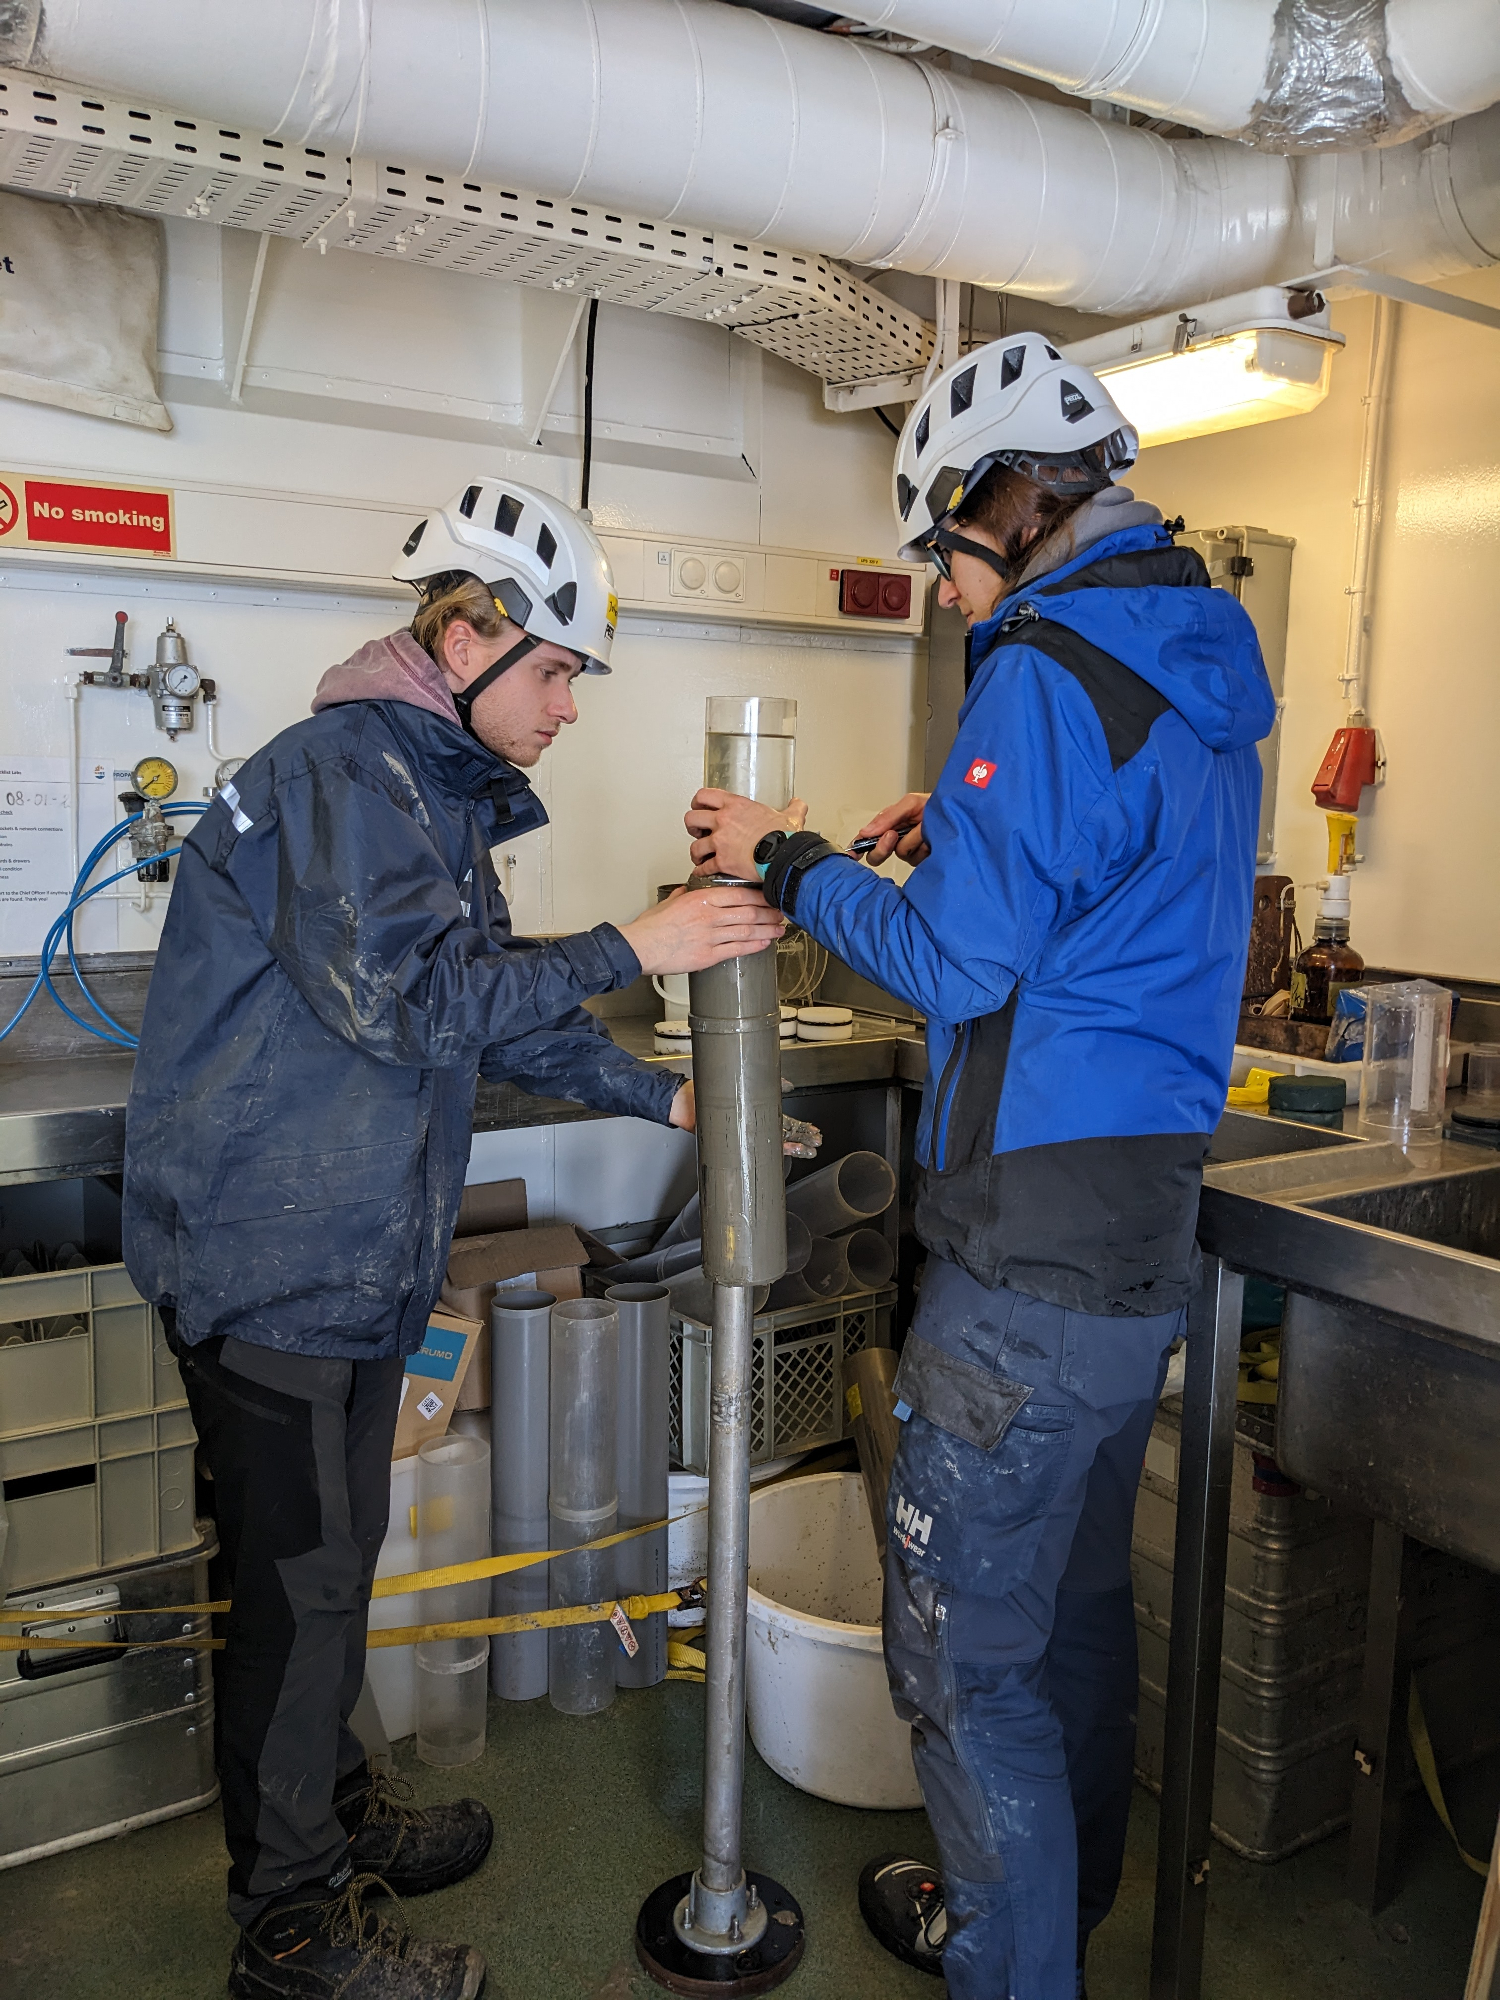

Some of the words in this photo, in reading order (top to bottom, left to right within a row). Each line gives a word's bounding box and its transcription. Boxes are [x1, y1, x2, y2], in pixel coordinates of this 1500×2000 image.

[0, 256, 15, 274] t
[33, 501, 64, 520] No
[71, 508, 165, 532] smoking
